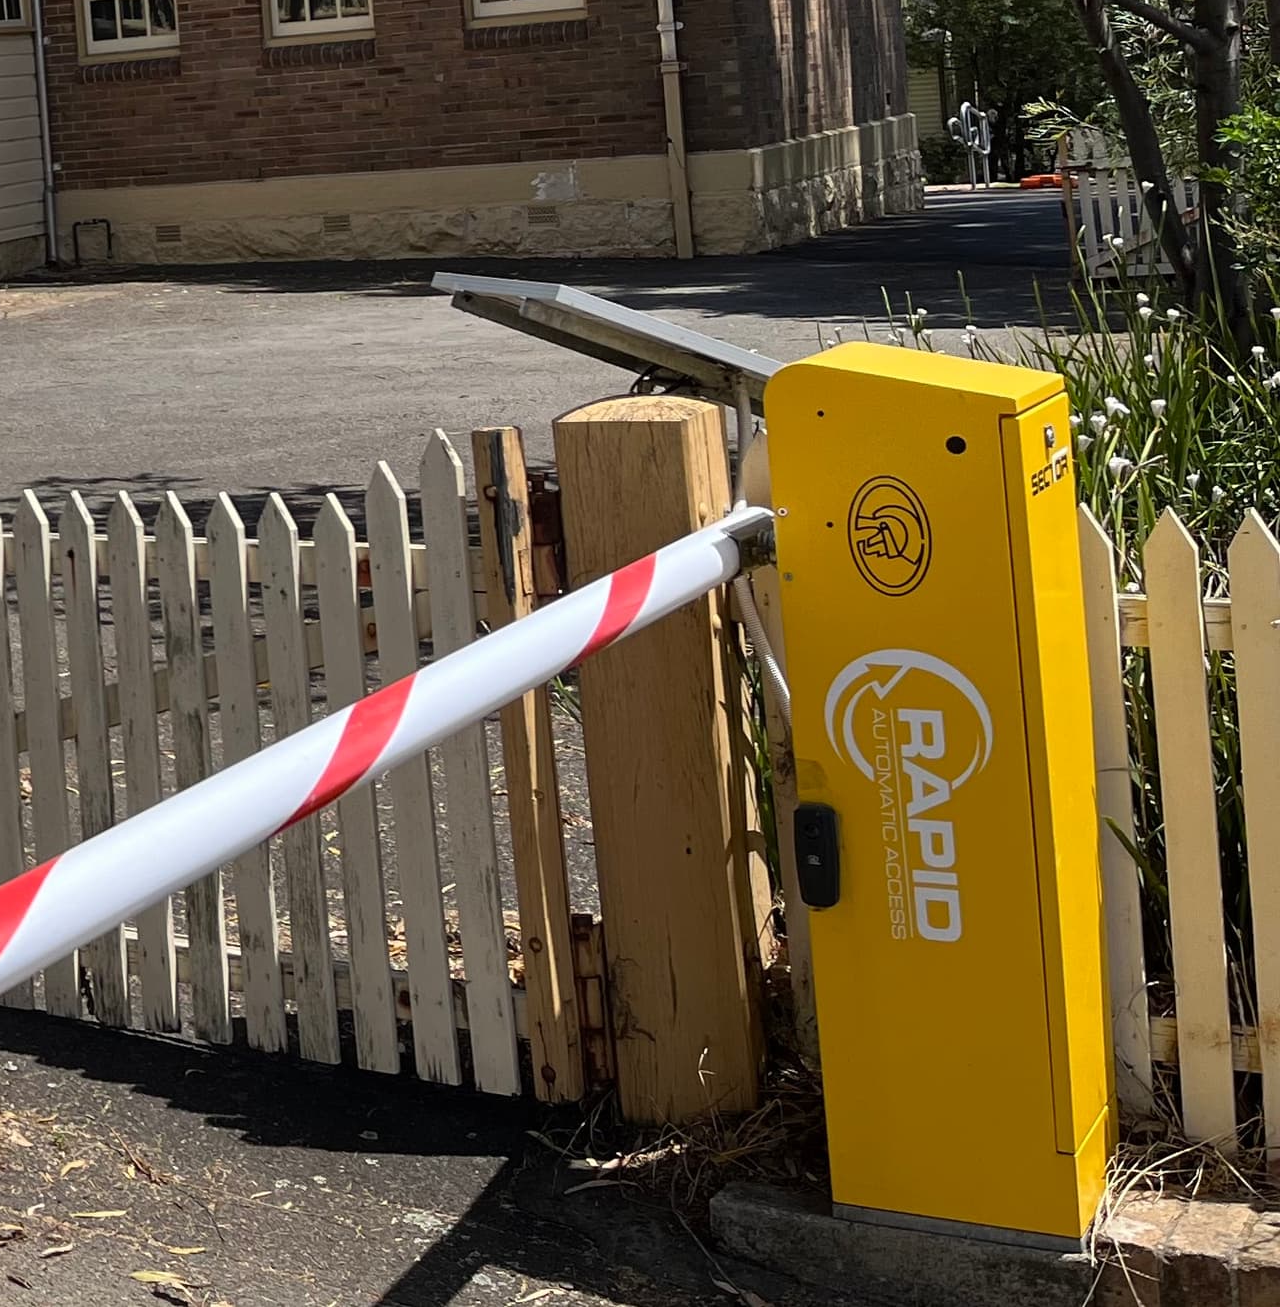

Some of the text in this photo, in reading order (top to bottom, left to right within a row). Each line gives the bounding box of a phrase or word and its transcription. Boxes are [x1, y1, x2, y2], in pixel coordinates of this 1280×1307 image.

[1031, 447, 1068, 496] SECTOR
[871, 708, 907, 940] AUTOMATIC ACCESS
[897, 708, 962, 942] RAPID
